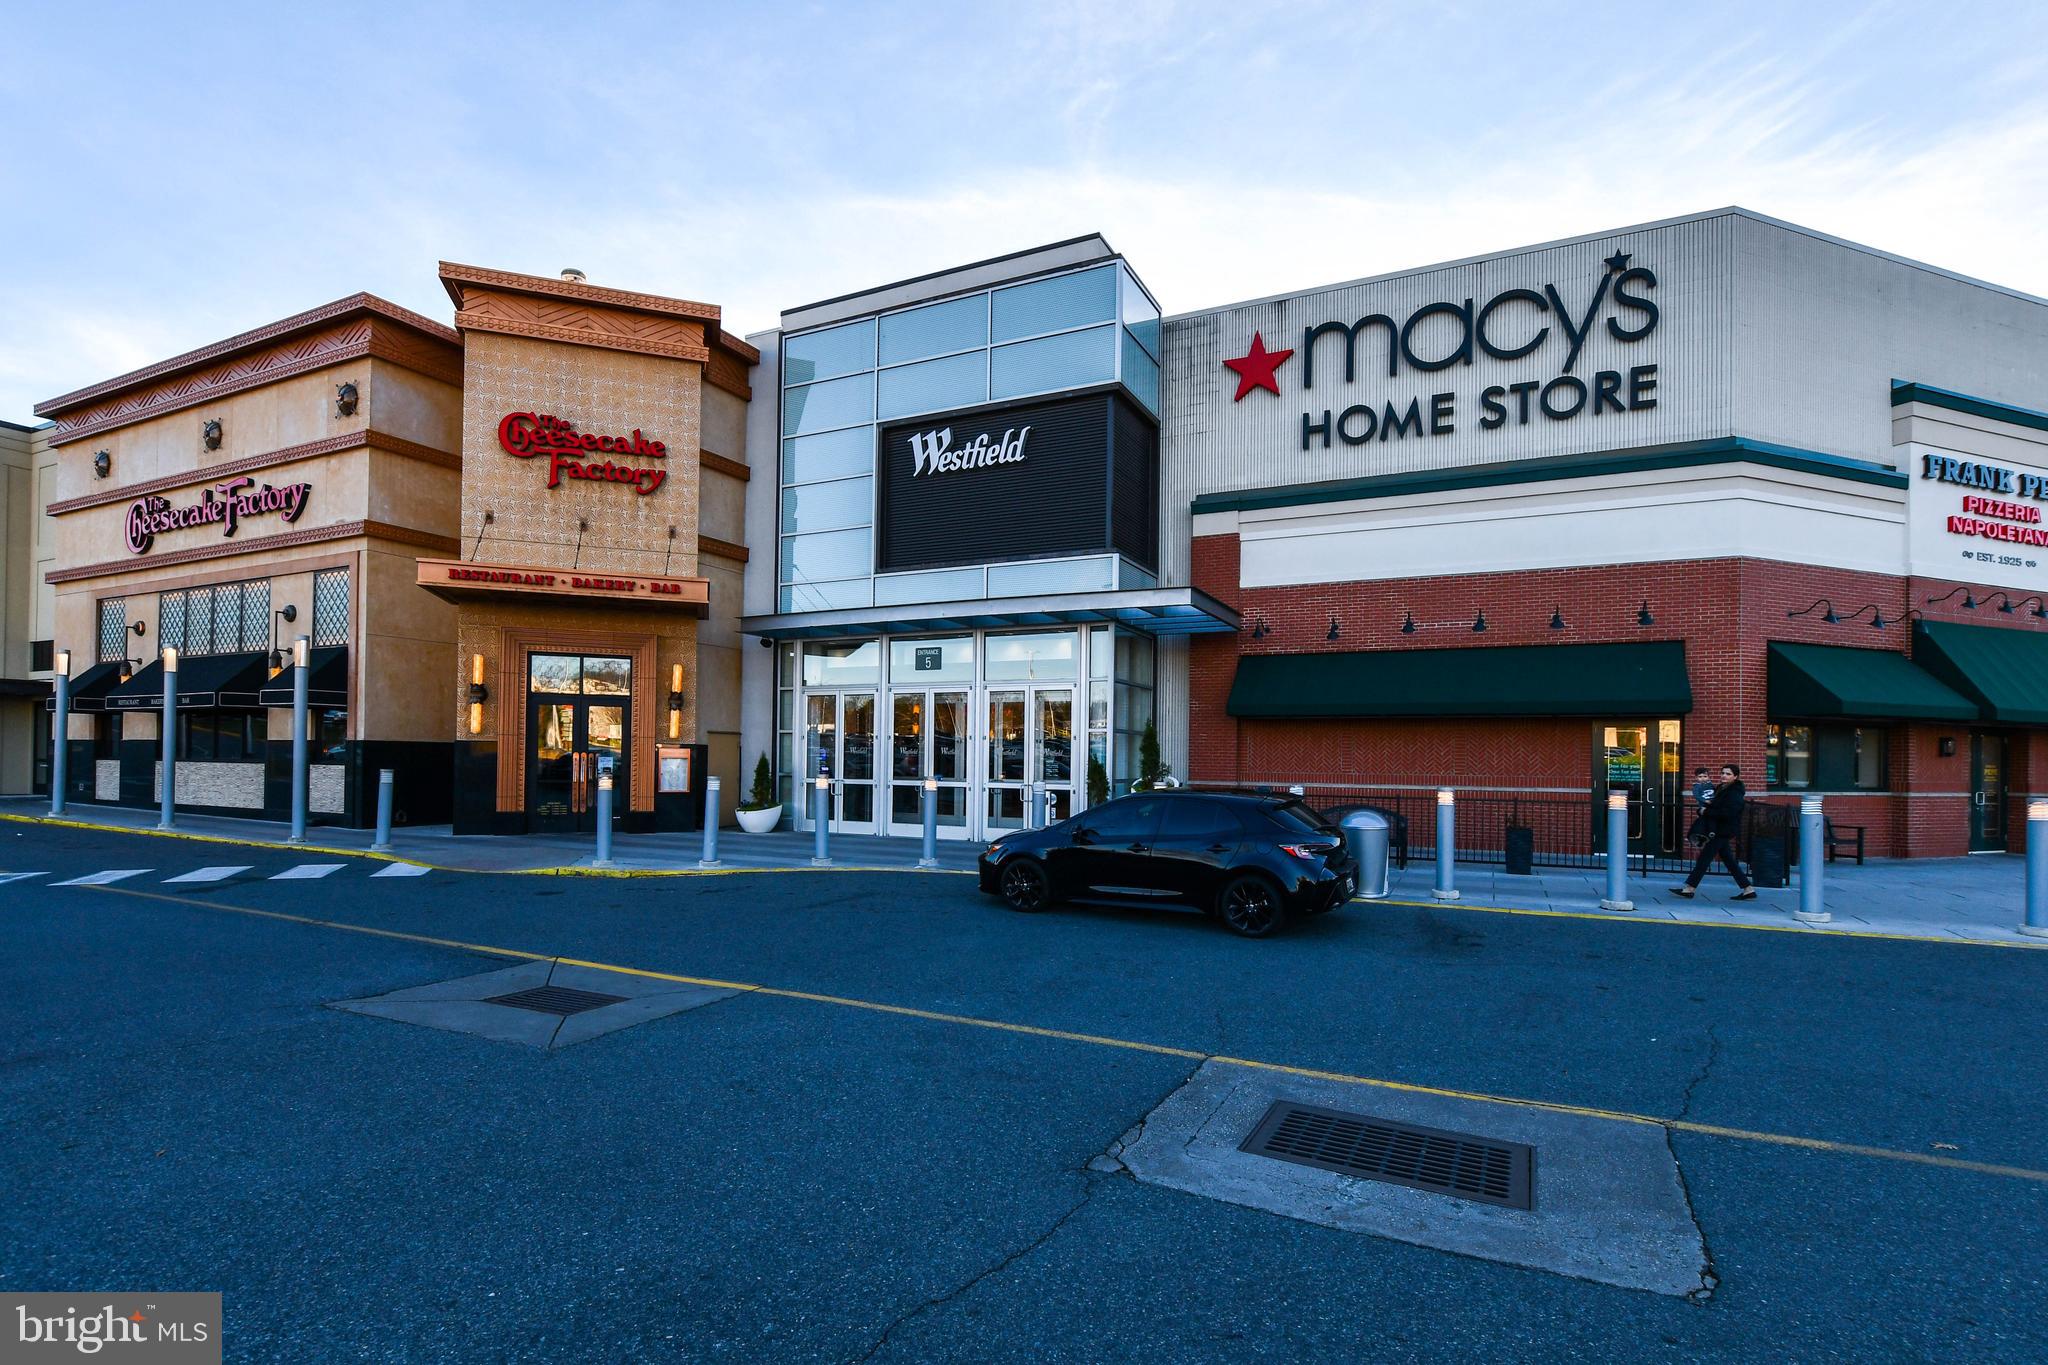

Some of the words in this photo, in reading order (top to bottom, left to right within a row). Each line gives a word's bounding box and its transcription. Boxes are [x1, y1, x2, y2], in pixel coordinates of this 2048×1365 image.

[1304, 249, 1660, 389] macy's
[539, 414, 572, 431] The
[1303, 391, 1456, 451] HOME
[1479, 364, 1658, 430] STORE
[498, 411, 667, 458] Cheesecake
[907, 426, 1032, 477] Westfield
[533, 447, 667, 496] Factory
[1921, 454, 2015, 494] FRANK
[125, 489, 223, 555] Cheesecake
[215, 477, 312, 537] Factory
[147, 496, 170, 512] The
[1963, 495, 2042, 524] PIZZERIA
[1976, 551, 1996, 563] EST.
[1998, 556, 2022, 567] 1925
[448, 568, 555, 587] RESTAURANT
[572, 577, 637, 592] BAKERY
[651, 582, 681, 595] BAR
[925, 656, 932, 669] 5
